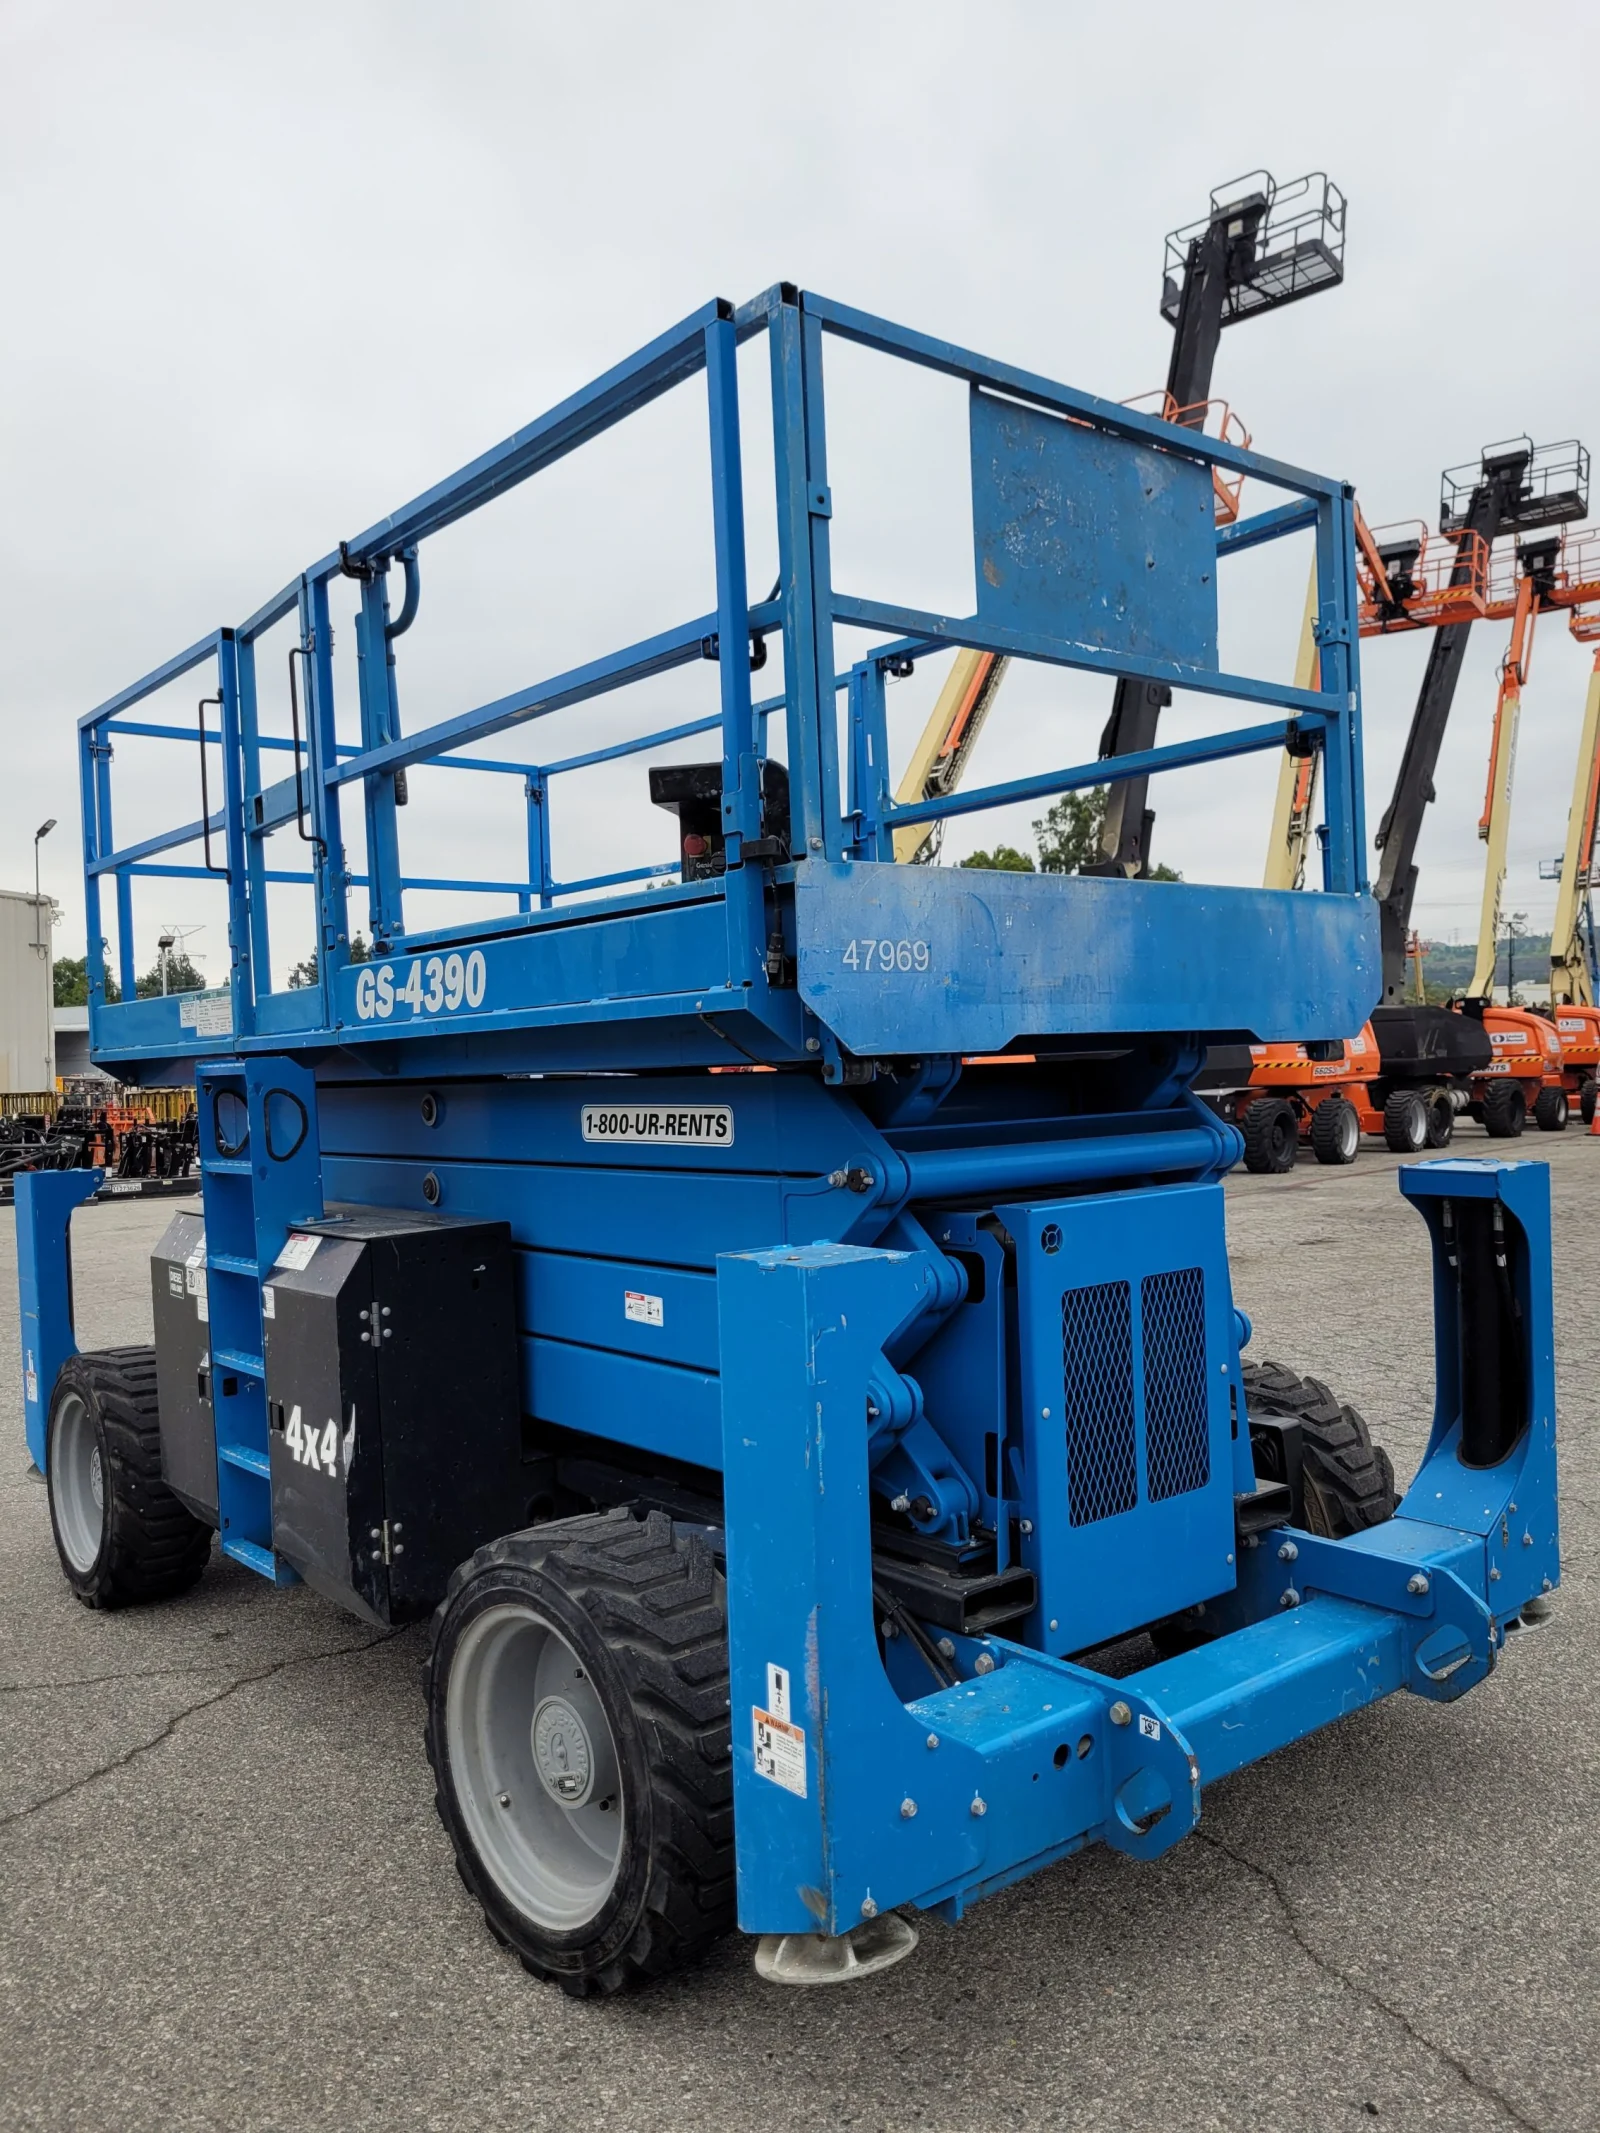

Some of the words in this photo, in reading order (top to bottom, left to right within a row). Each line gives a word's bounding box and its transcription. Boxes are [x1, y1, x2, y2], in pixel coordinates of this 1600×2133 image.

[842, 939, 929, 972] 47969
[356, 950, 487, 1020] GS-4390
[586, 1113, 728, 1138] 1-800-UR-RENTS
[285, 1404, 337, 1478] 4x4
